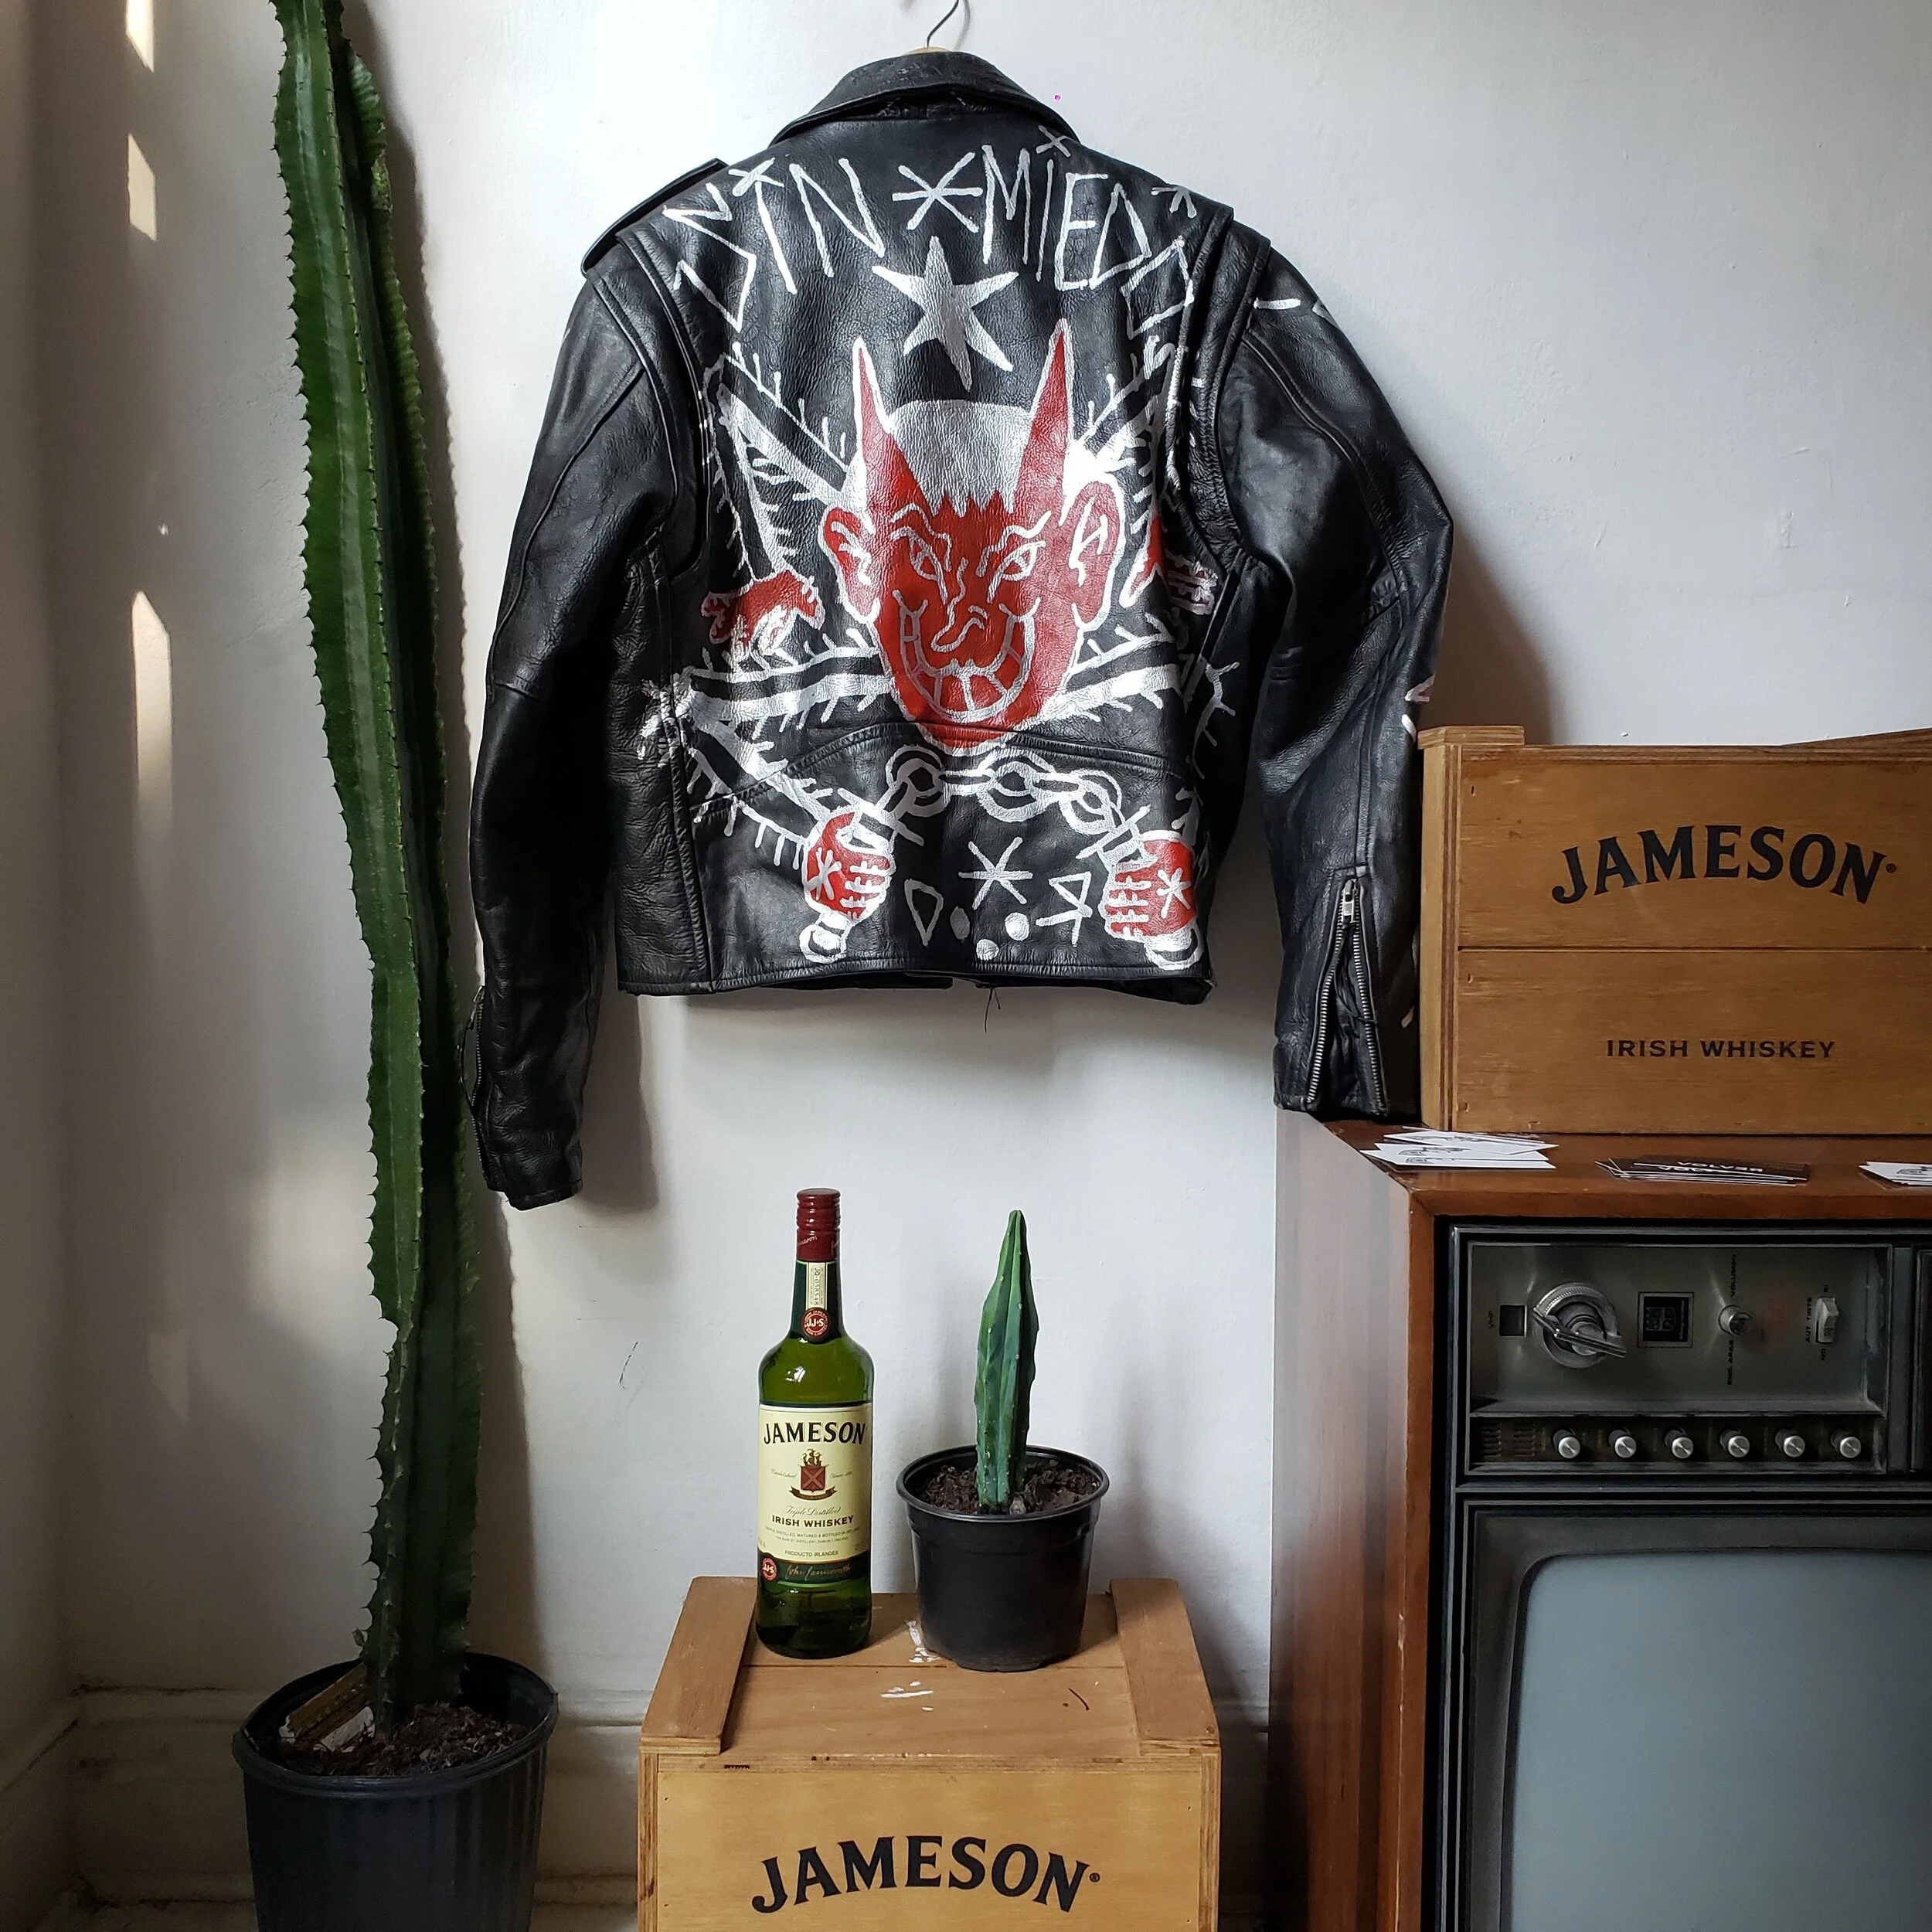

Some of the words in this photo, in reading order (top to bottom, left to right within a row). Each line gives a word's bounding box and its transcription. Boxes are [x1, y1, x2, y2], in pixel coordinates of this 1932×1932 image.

[1551, 825, 1887, 904] JAMESON
[1607, 1039, 1689, 1057] IRISH
[1700, 1040, 1835, 1058] WHISKEY
[764, 1421, 866, 1445] JAMESON
[772, 1515, 800, 1527] IRISH
[804, 1515, 854, 1528] WHISKEY
[751, 1835, 1090, 1913] JAMESON
